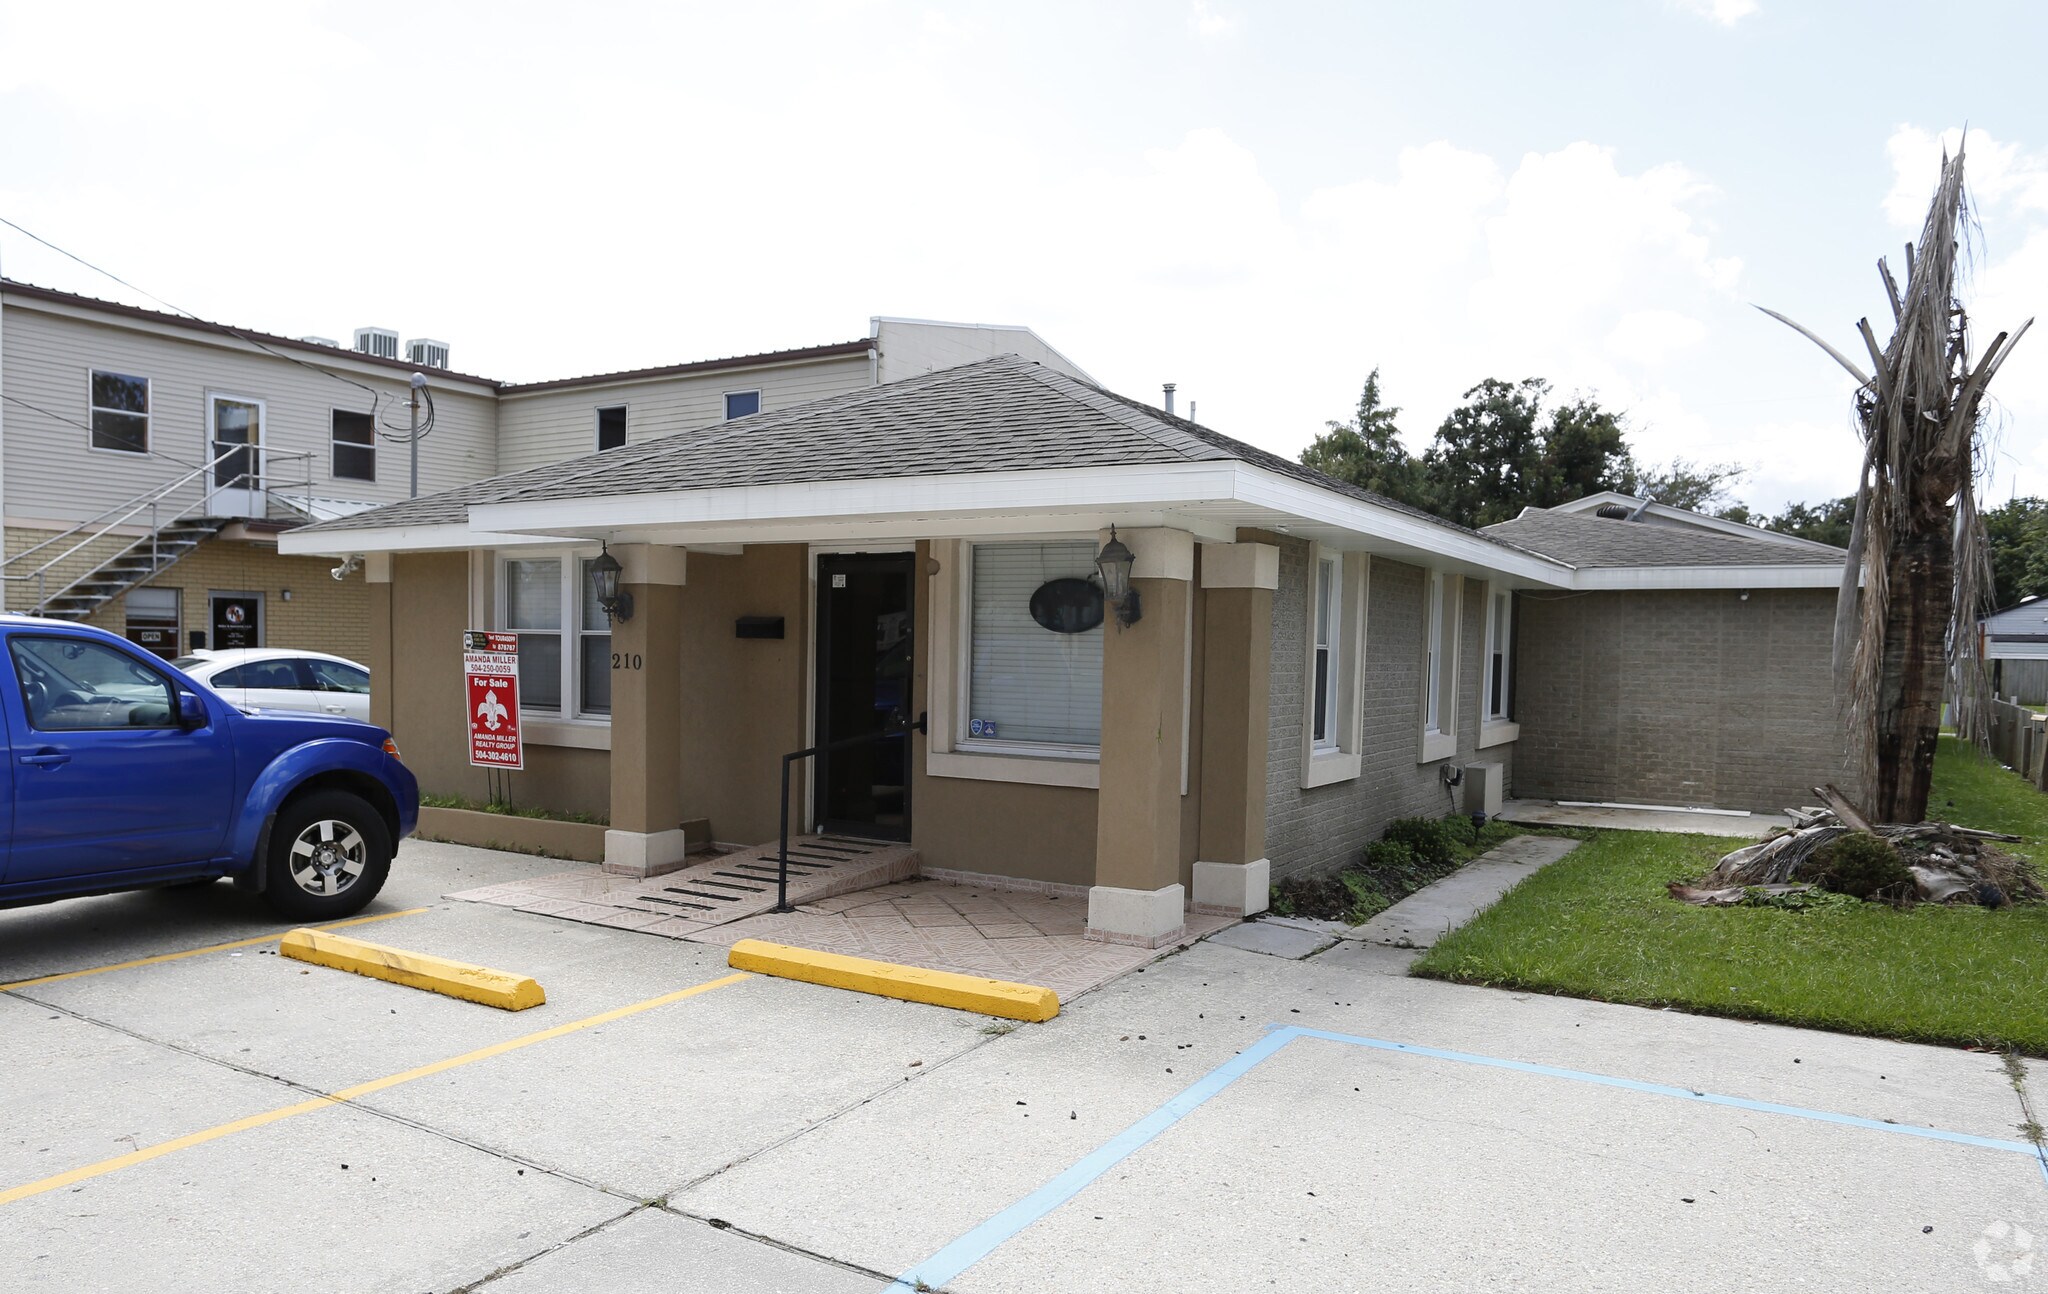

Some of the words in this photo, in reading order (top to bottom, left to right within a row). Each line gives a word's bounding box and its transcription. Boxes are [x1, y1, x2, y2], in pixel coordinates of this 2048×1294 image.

[465, 655, 491, 663] AMANDA
[492, 656, 516, 664] MILLER
[612, 653, 641, 670] 210
[471, 664, 511, 673] 504-250-0059
[474, 677, 487, 687] For
[489, 678, 508, 688] Sale
[473, 733, 495, 741] AMANDA
[495, 742, 516, 750] GROUP
[475, 750, 517, 762] 504-302-4610
